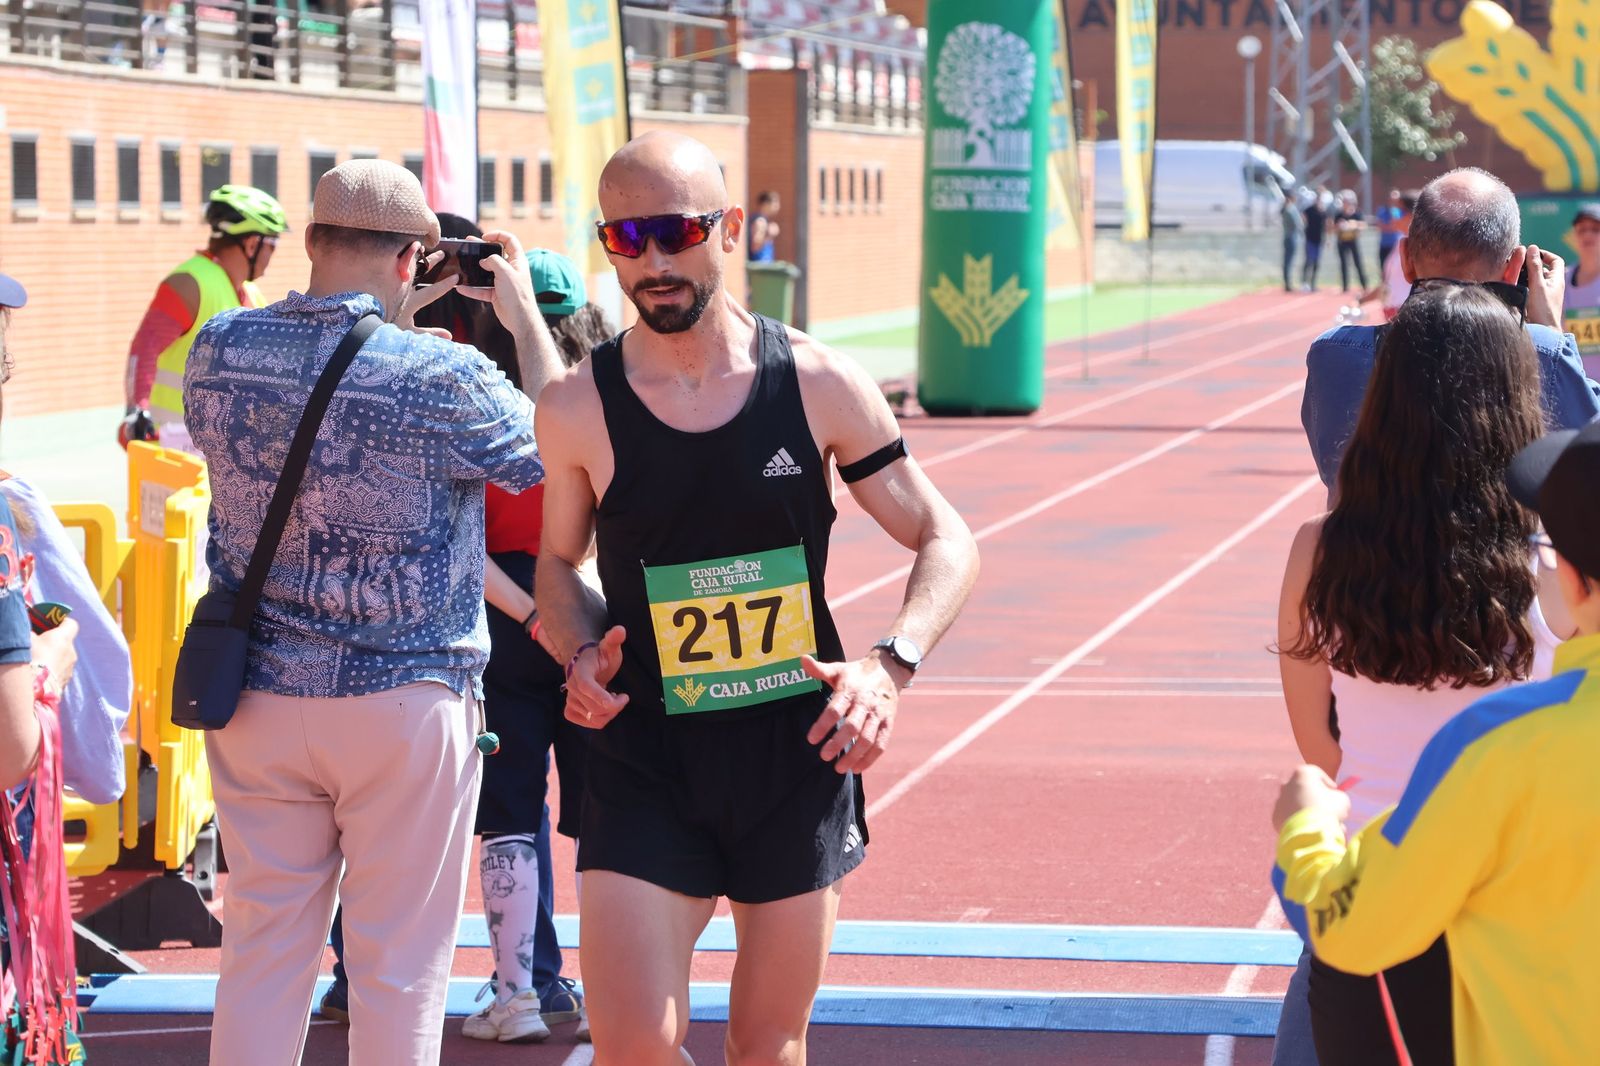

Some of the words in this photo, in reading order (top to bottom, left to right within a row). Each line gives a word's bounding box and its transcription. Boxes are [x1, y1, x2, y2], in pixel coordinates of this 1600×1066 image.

[930, 192, 969, 210] CAJA
[973, 193, 1033, 212] RURAL
[763, 466, 802, 477] adidas
[691, 577, 720, 589] CAJA
[722, 571, 764, 586] RURAL
[705, 587, 733, 595] ZAMORA
[672, 596, 783, 663] 217
[709, 681, 752, 698] CAJA
[755, 668, 813, 692] RURAL
